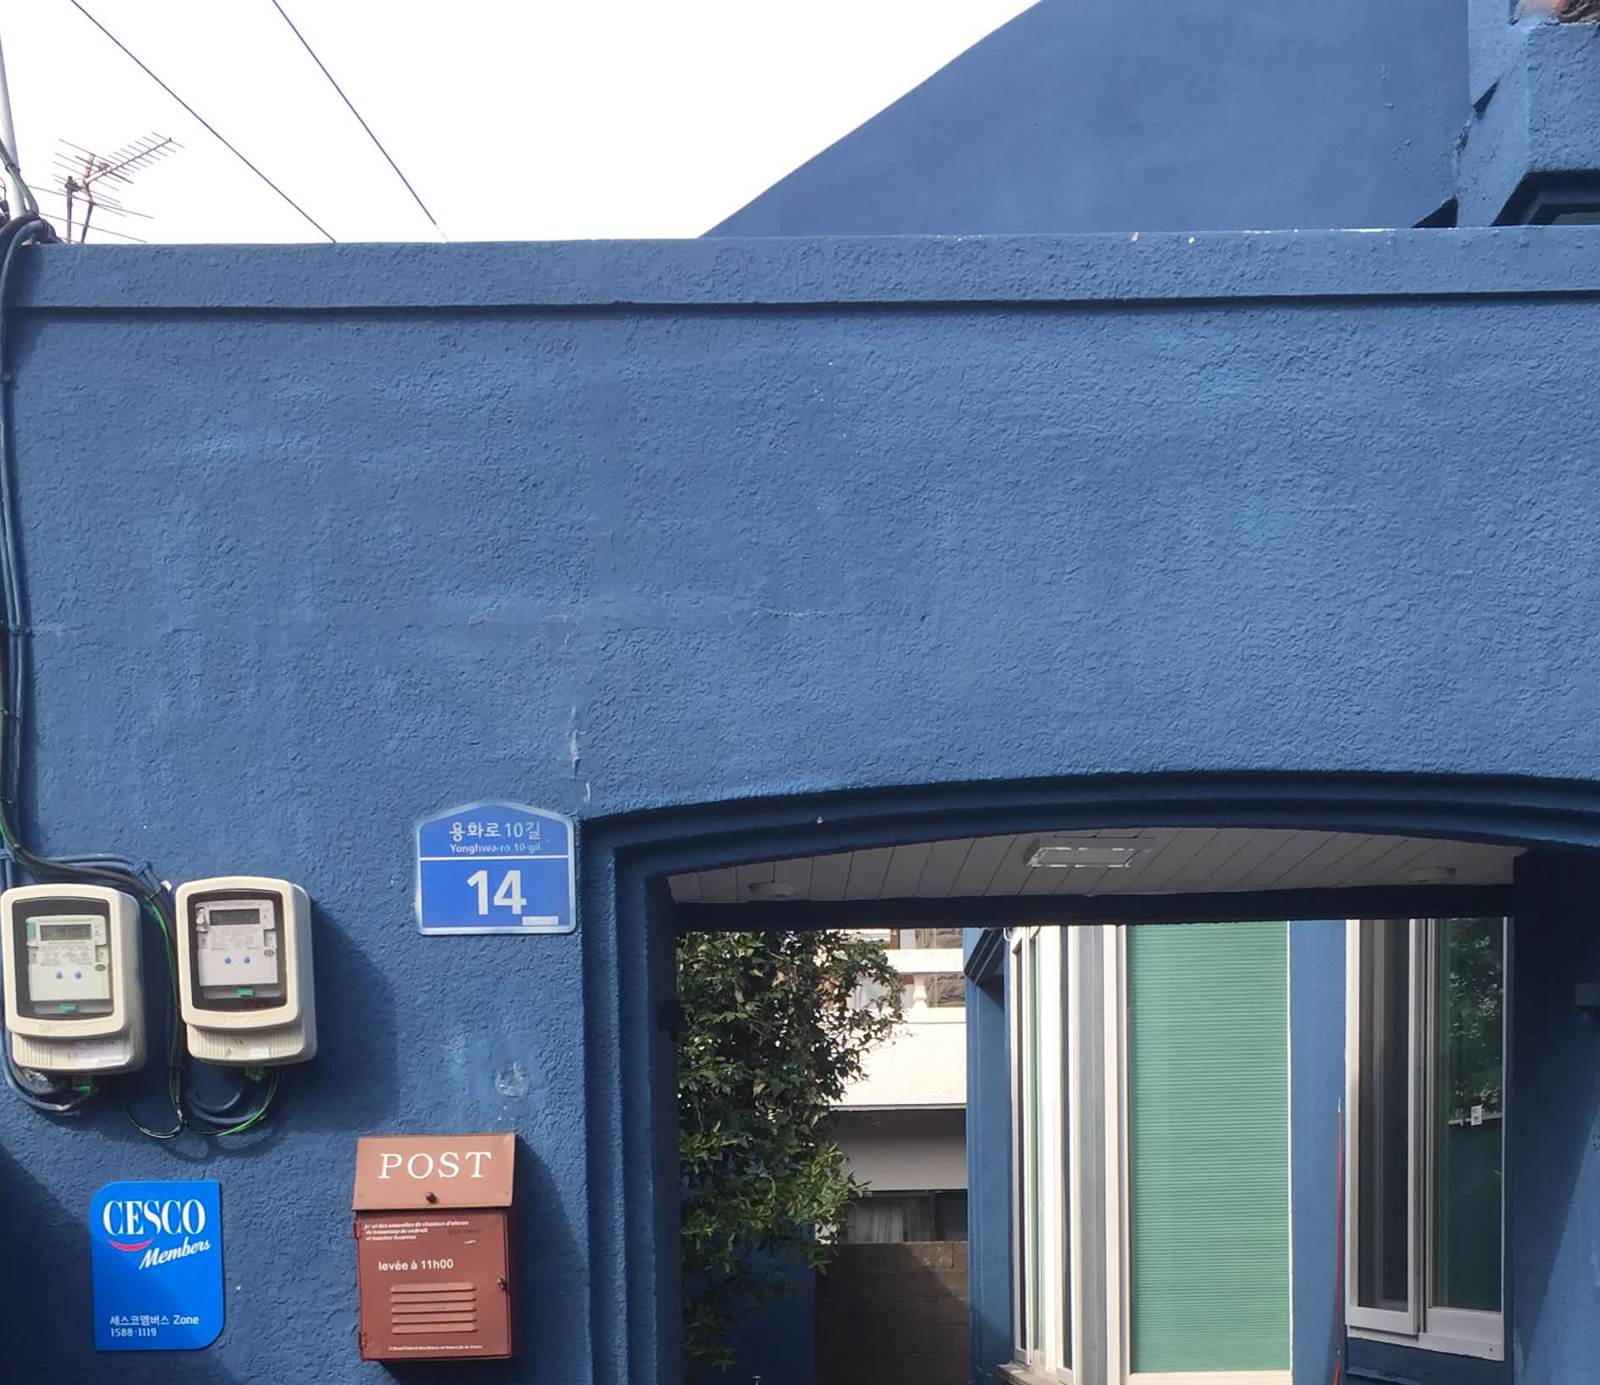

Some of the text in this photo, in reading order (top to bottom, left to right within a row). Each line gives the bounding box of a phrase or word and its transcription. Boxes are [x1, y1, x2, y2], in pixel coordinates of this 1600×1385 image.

[449, 842, 541, 855] Yonghwa-ro 10-gil
[467, 869, 527, 915] 14
[378, 1151, 492, 1180] POST
[103, 1199, 206, 1236] CESCO
[138, 1236, 212, 1271] Members
[421, 1258, 454, 1270] 11h00
[172, 1314, 200, 1325] Zone
